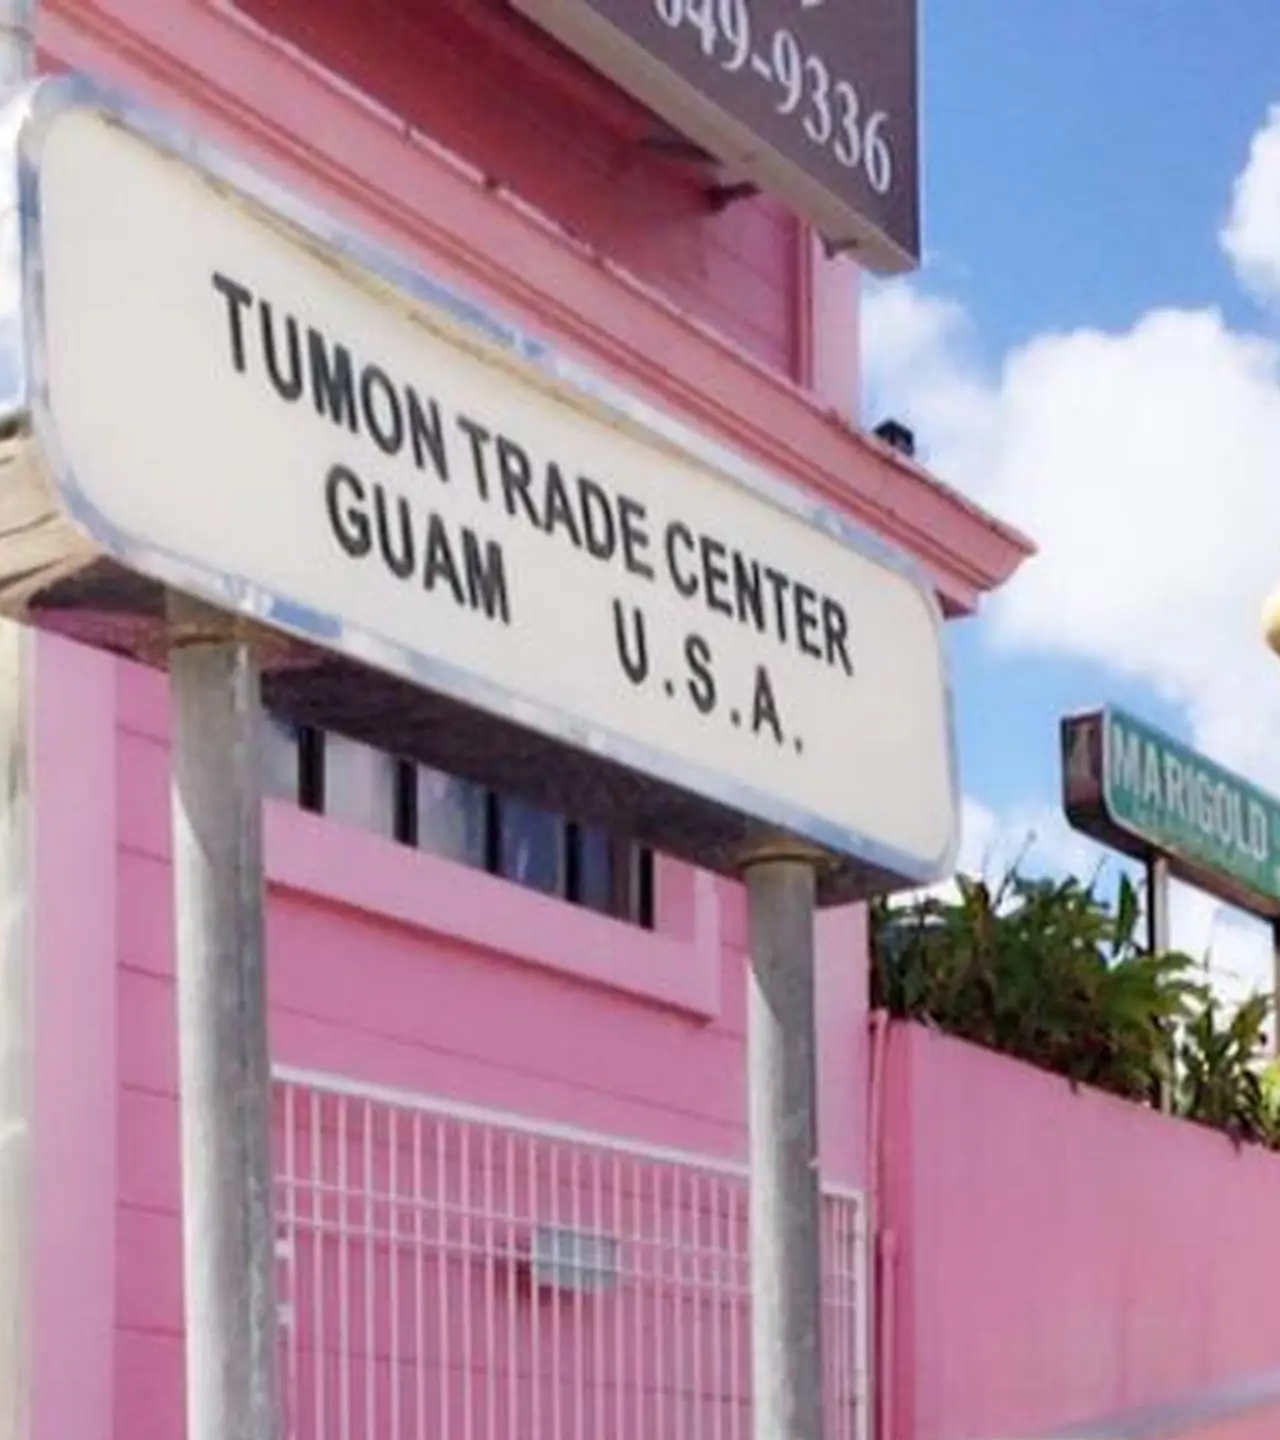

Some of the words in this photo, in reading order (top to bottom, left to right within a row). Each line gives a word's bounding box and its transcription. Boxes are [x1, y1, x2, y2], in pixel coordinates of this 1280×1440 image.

[212, 269, 450, 484] TUMON
[455, 413, 656, 583] TRADE
[663, 520, 855, 677] CENTER
[324, 463, 511, 625] GUAM
[1111, 722, 1270, 863] MARIGOLD
